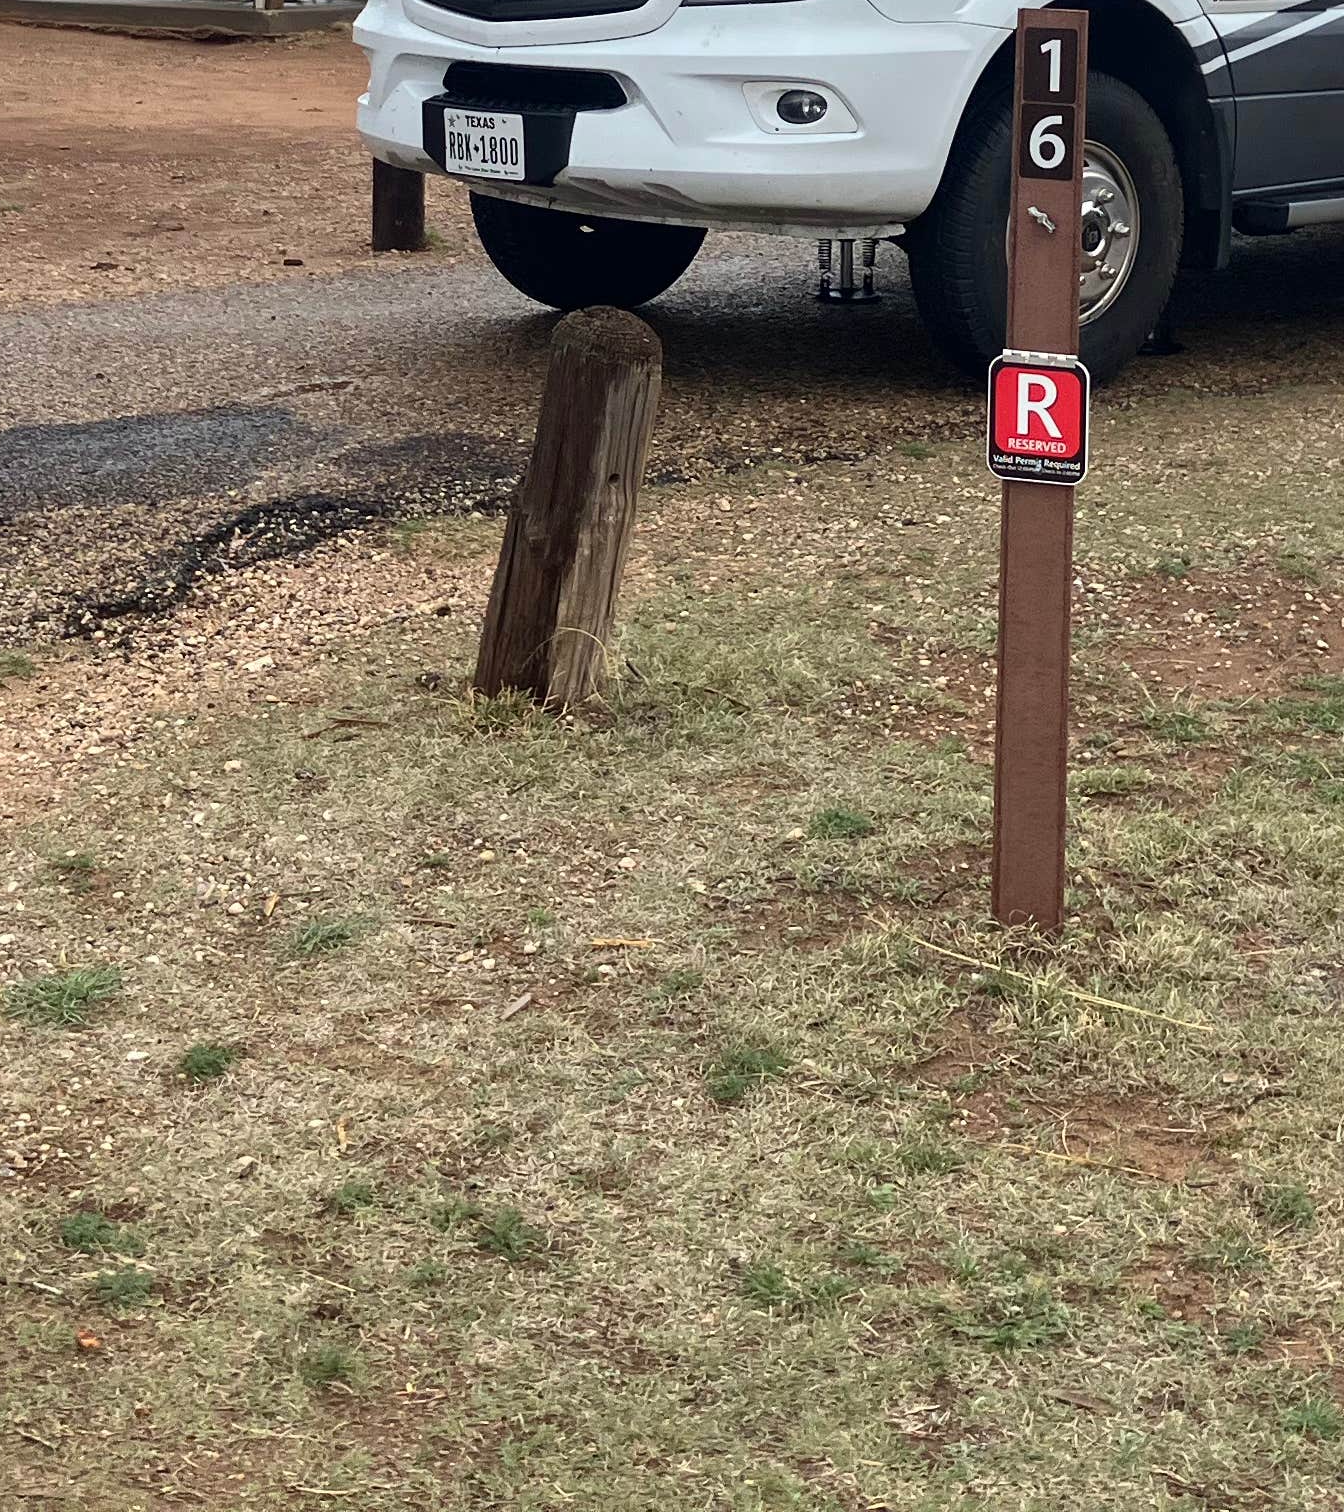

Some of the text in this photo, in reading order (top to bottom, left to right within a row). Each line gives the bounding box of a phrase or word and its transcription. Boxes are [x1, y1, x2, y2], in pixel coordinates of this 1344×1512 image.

[464, 114, 496, 130] TEXAS
[1016, 372, 1063, 439] R
[1007, 437, 1067, 455] RESERVED
[992, 454, 1014, 465] Valid
[1043, 459, 1081, 471] Required
